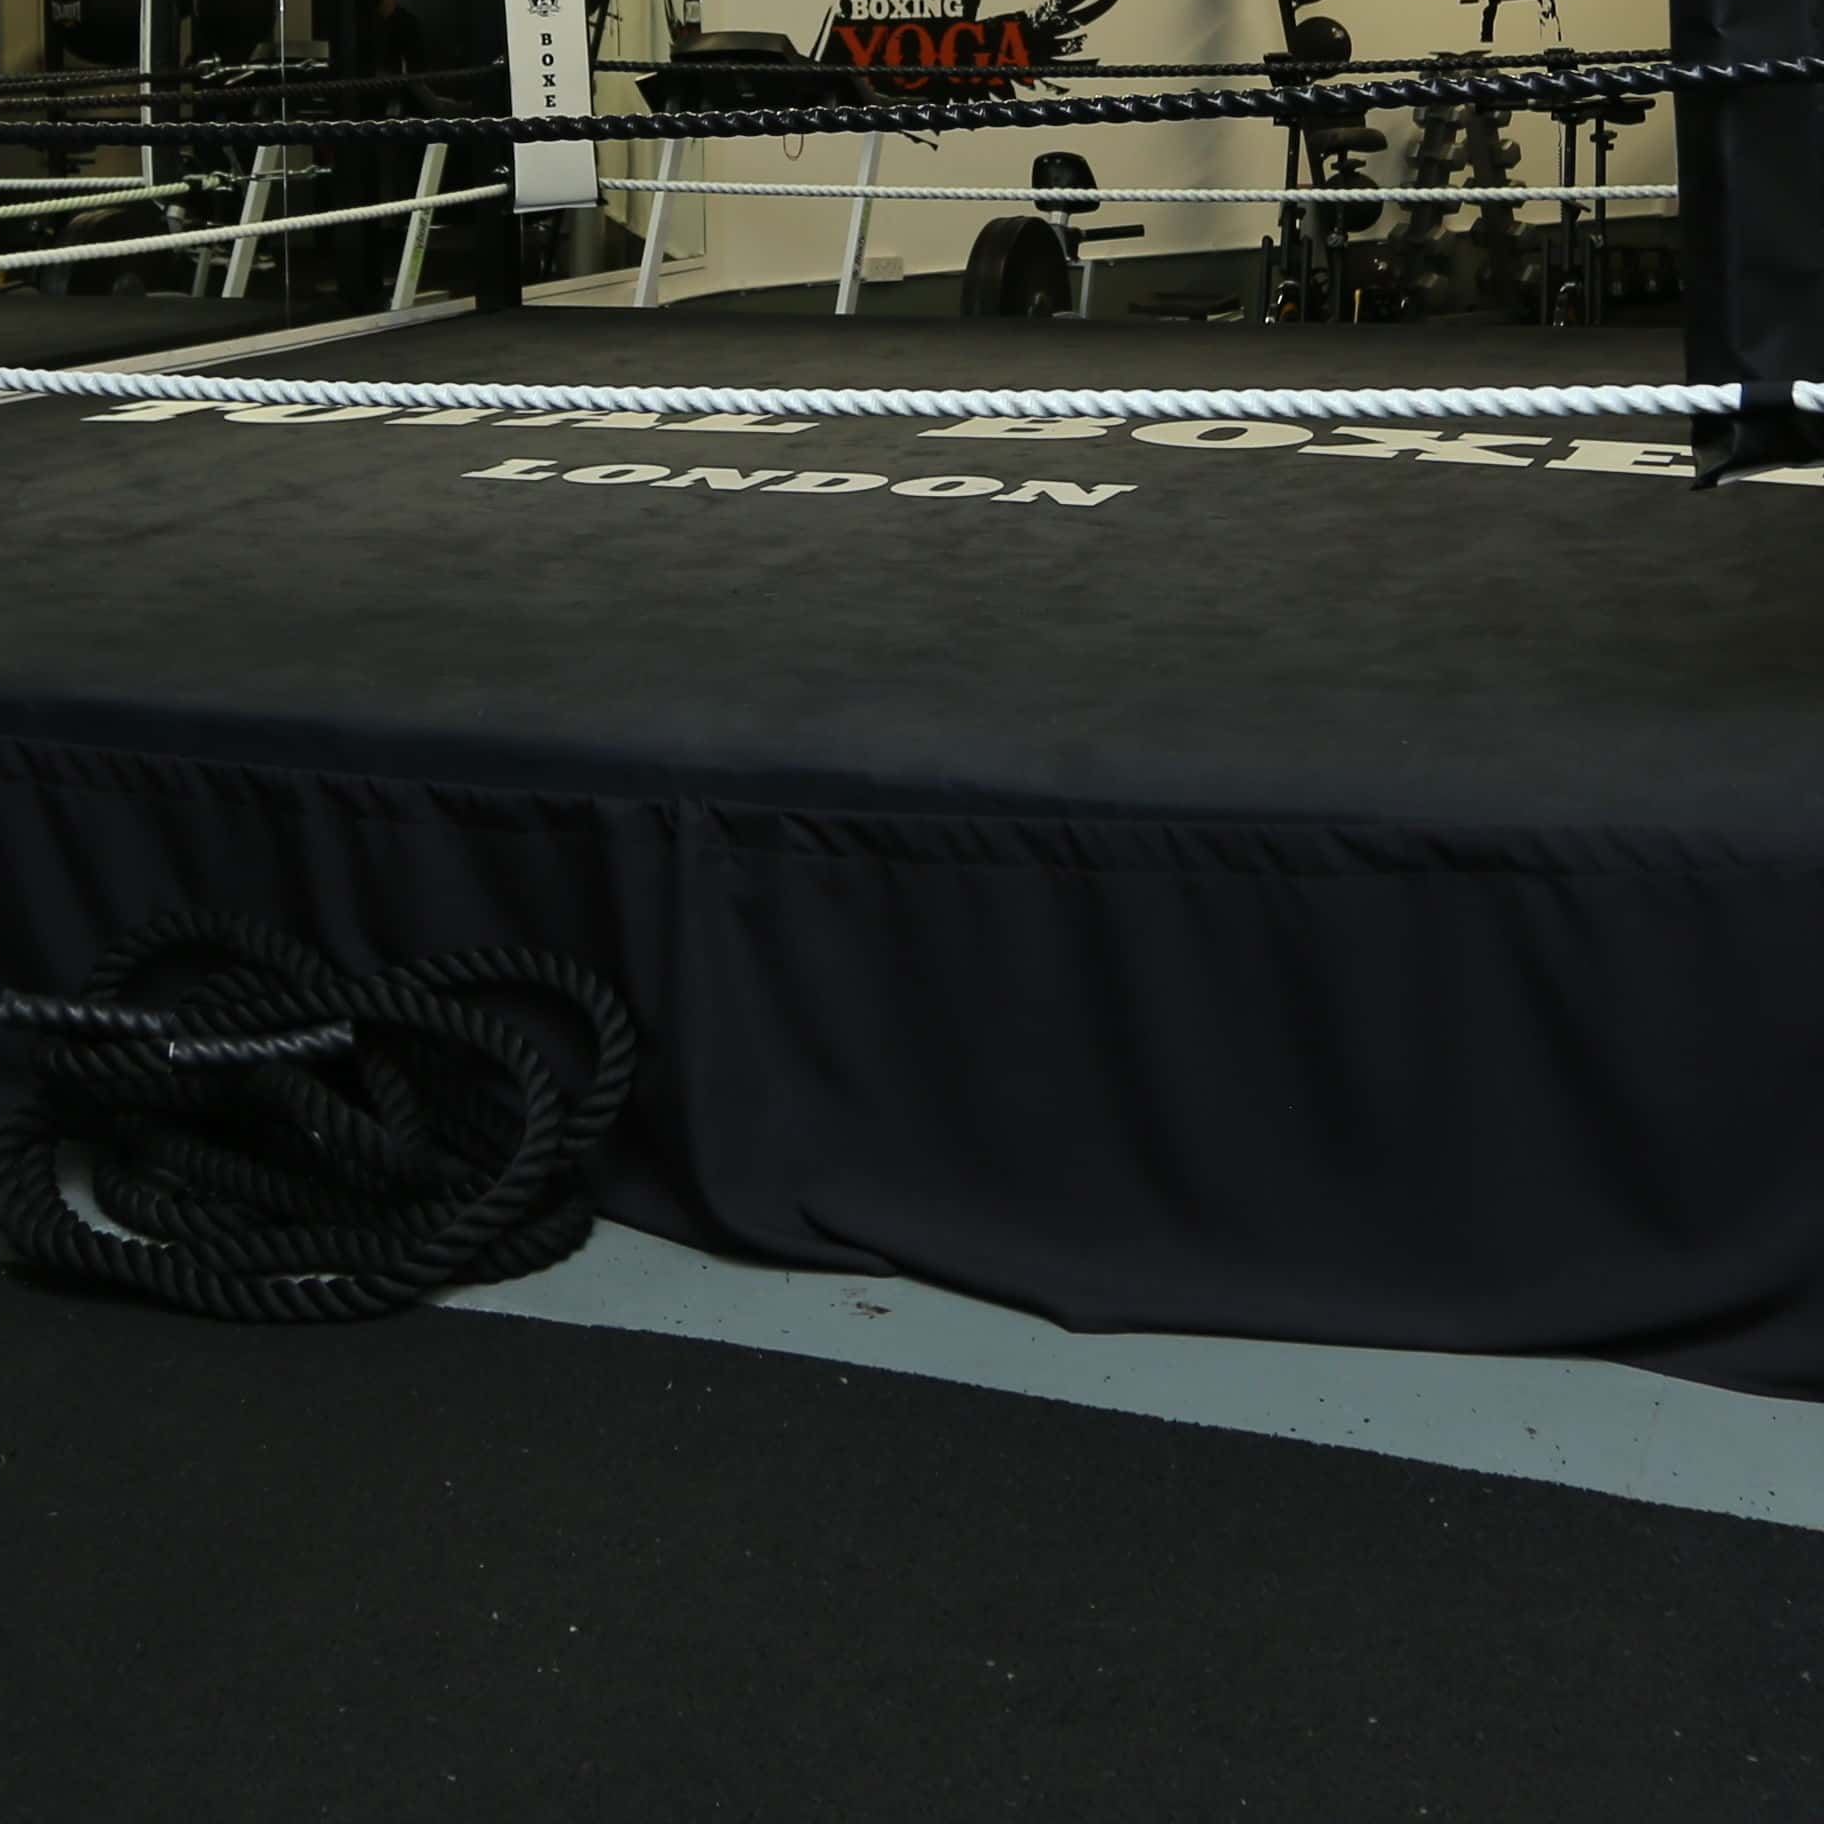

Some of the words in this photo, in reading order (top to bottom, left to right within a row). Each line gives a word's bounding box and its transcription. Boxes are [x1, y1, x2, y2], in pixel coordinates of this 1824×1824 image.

[540, 33, 557, 117] BOXE
[832, 20, 1036, 90] YOGA
[461, 458, 1139, 507] LONDON
